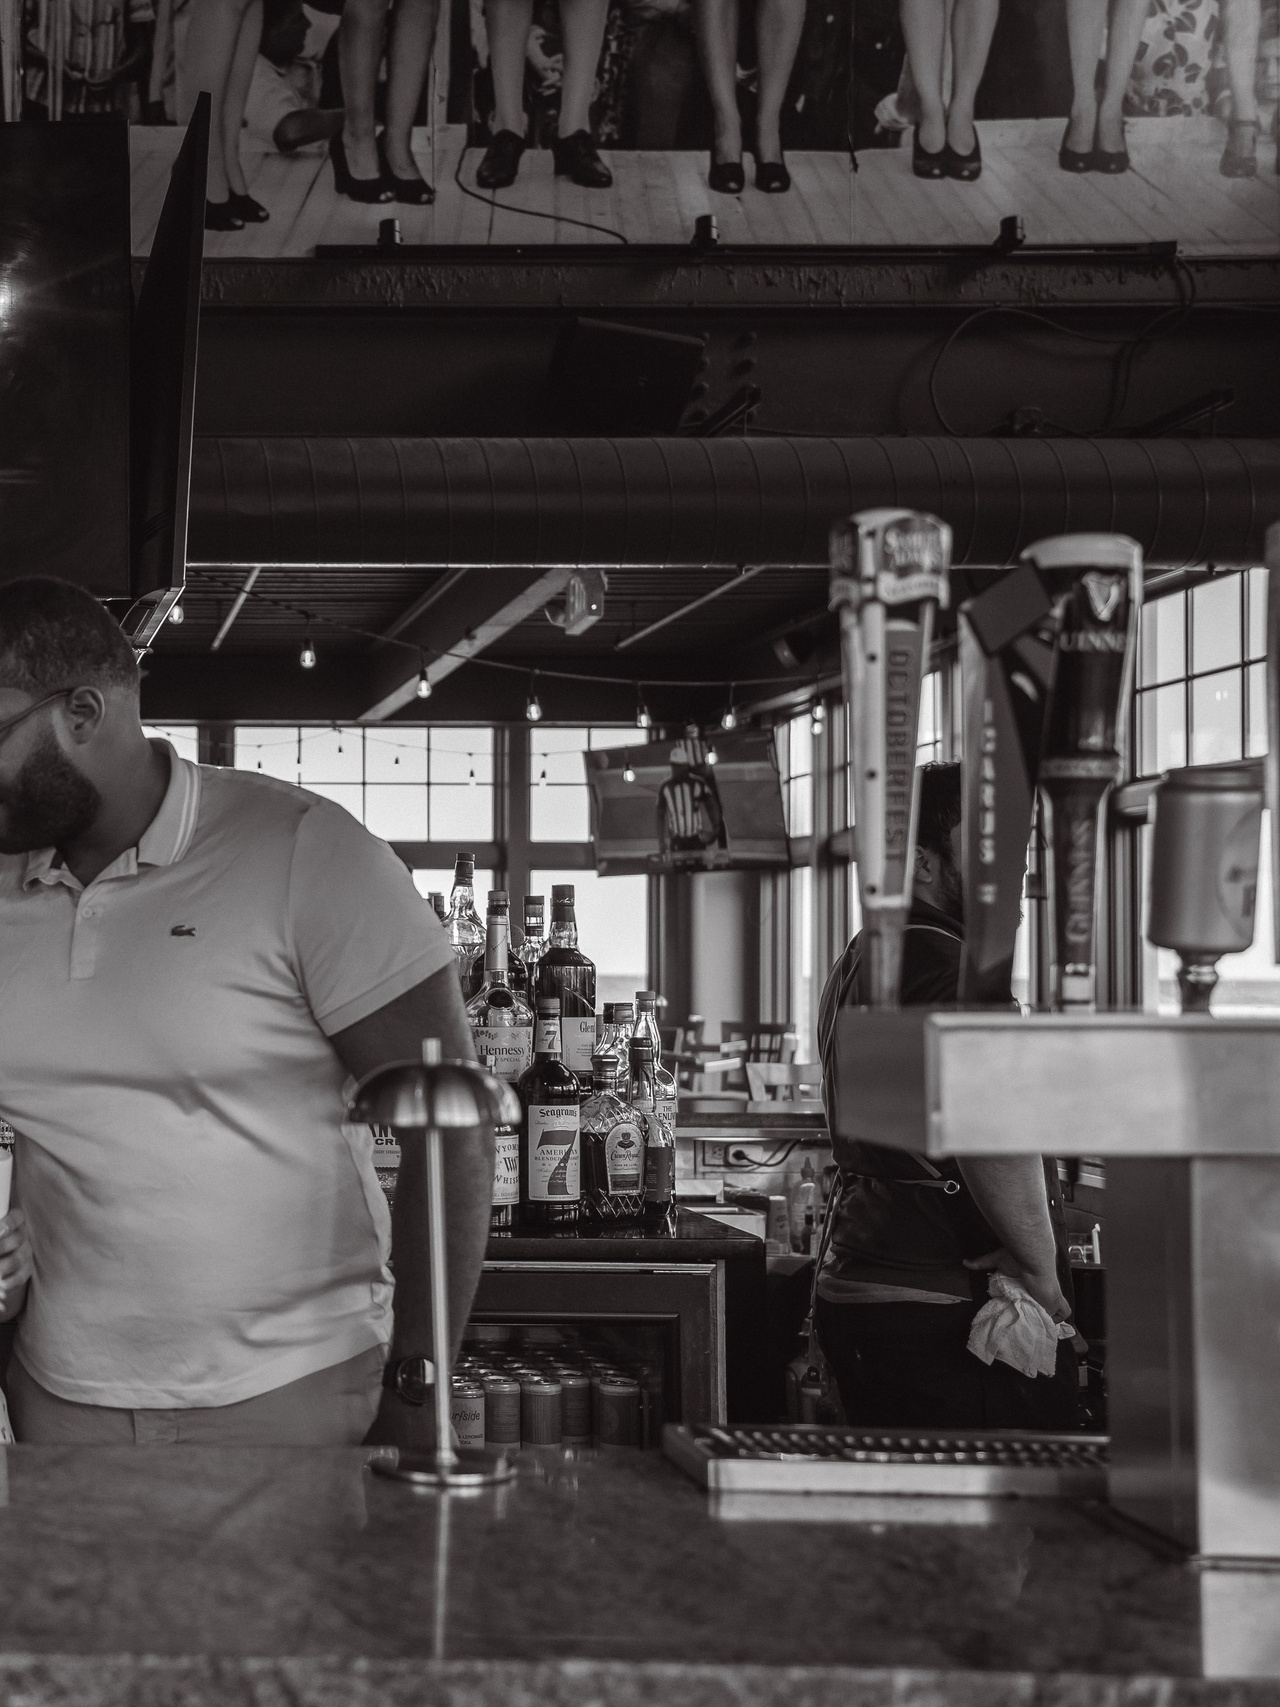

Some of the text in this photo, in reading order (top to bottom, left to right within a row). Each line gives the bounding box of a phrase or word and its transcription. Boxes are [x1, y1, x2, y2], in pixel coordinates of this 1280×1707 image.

[885, 651, 910, 861] OCTOBERFEST
[545, 1030, 557, 1050] 7
[480, 1044, 524, 1058] Hennessy
[539, 1108, 578, 1119] Seagram's
[451, 1411, 481, 1421] urfside
